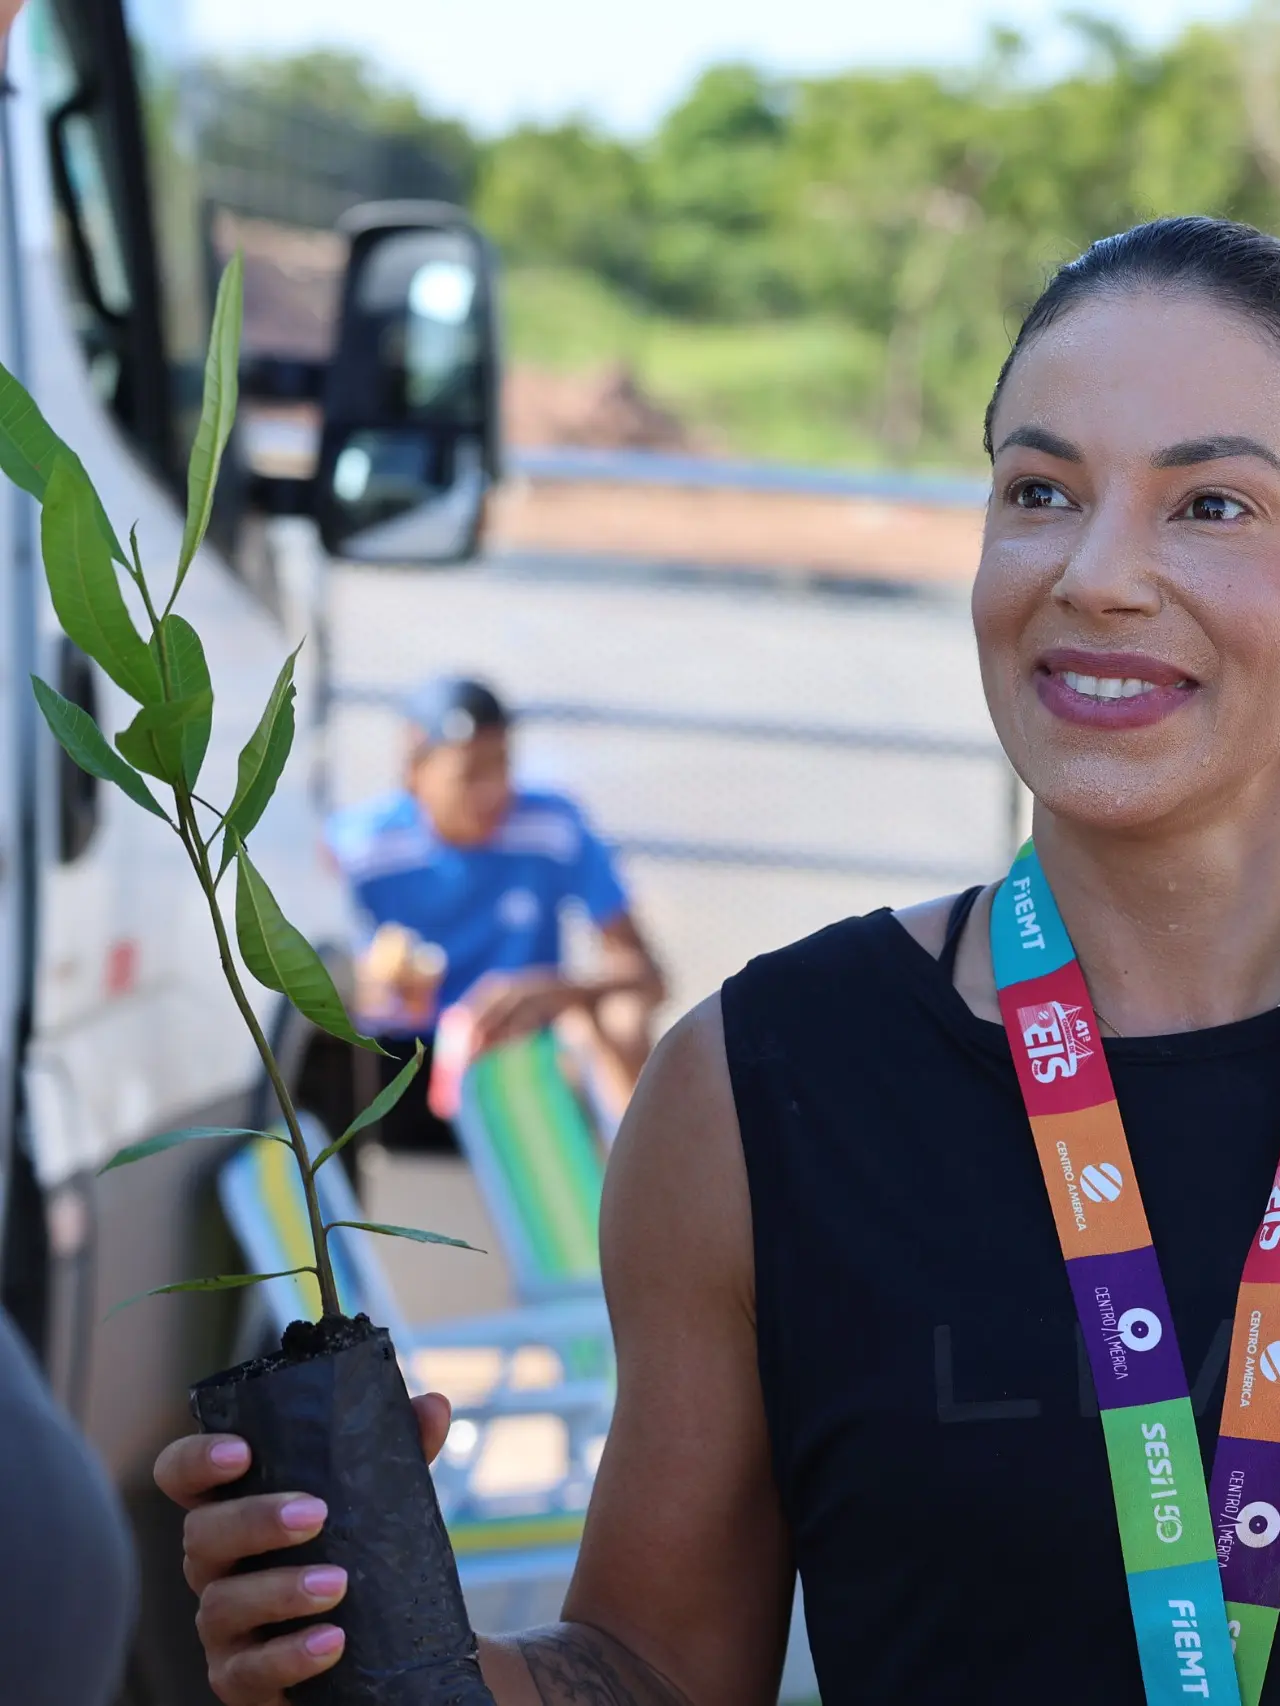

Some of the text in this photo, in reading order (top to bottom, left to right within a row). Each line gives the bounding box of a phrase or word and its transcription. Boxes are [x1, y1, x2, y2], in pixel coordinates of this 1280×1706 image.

[1056, 1140, 1087, 1232] CENTRO AMÉRICA
[1094, 1286, 1115, 1327] CENTRO
[1239, 1310, 1261, 1408] CENTRO AMÉRICA
[1225, 1470, 1245, 1514] CENTRO
